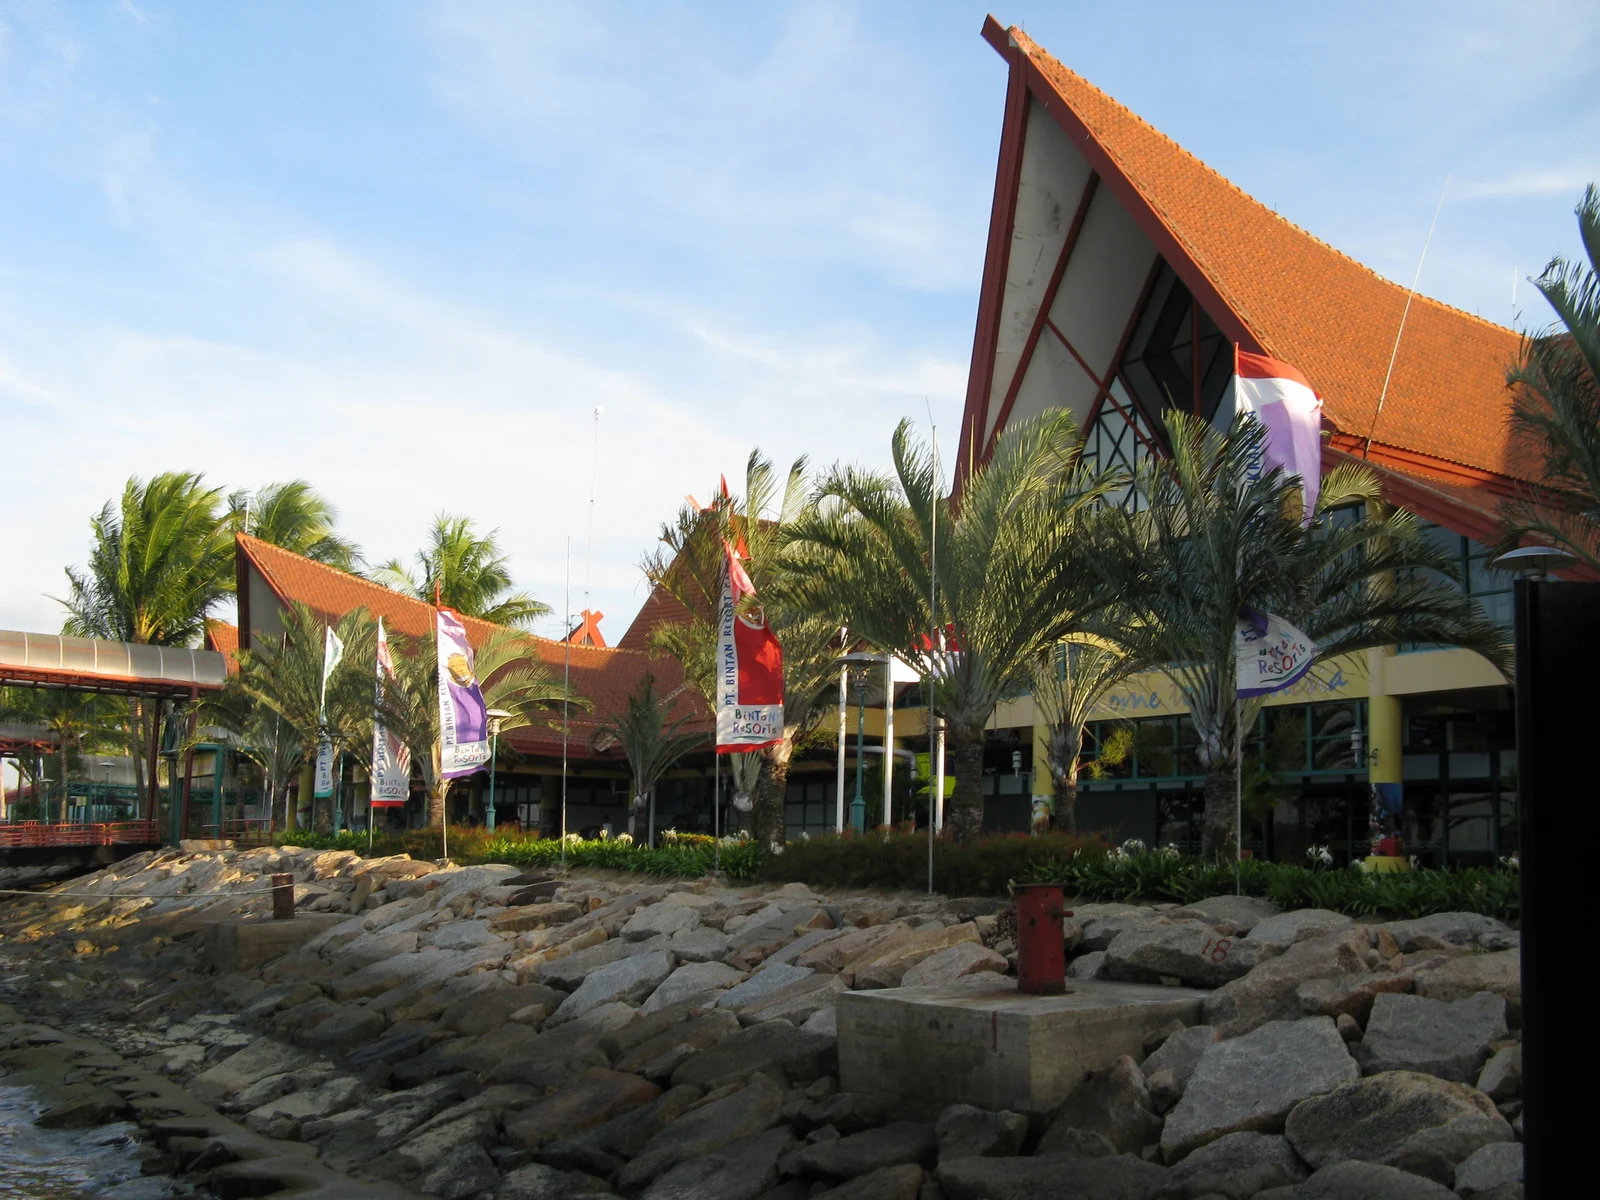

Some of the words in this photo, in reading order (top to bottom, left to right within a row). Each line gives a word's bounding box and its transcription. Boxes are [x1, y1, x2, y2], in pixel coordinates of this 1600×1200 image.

[723, 595, 733, 637] RESORT
[724, 644, 735, 685] BINTAN
[442, 700, 454, 731] BINTAN
[1201, 937, 1232, 962] 18
